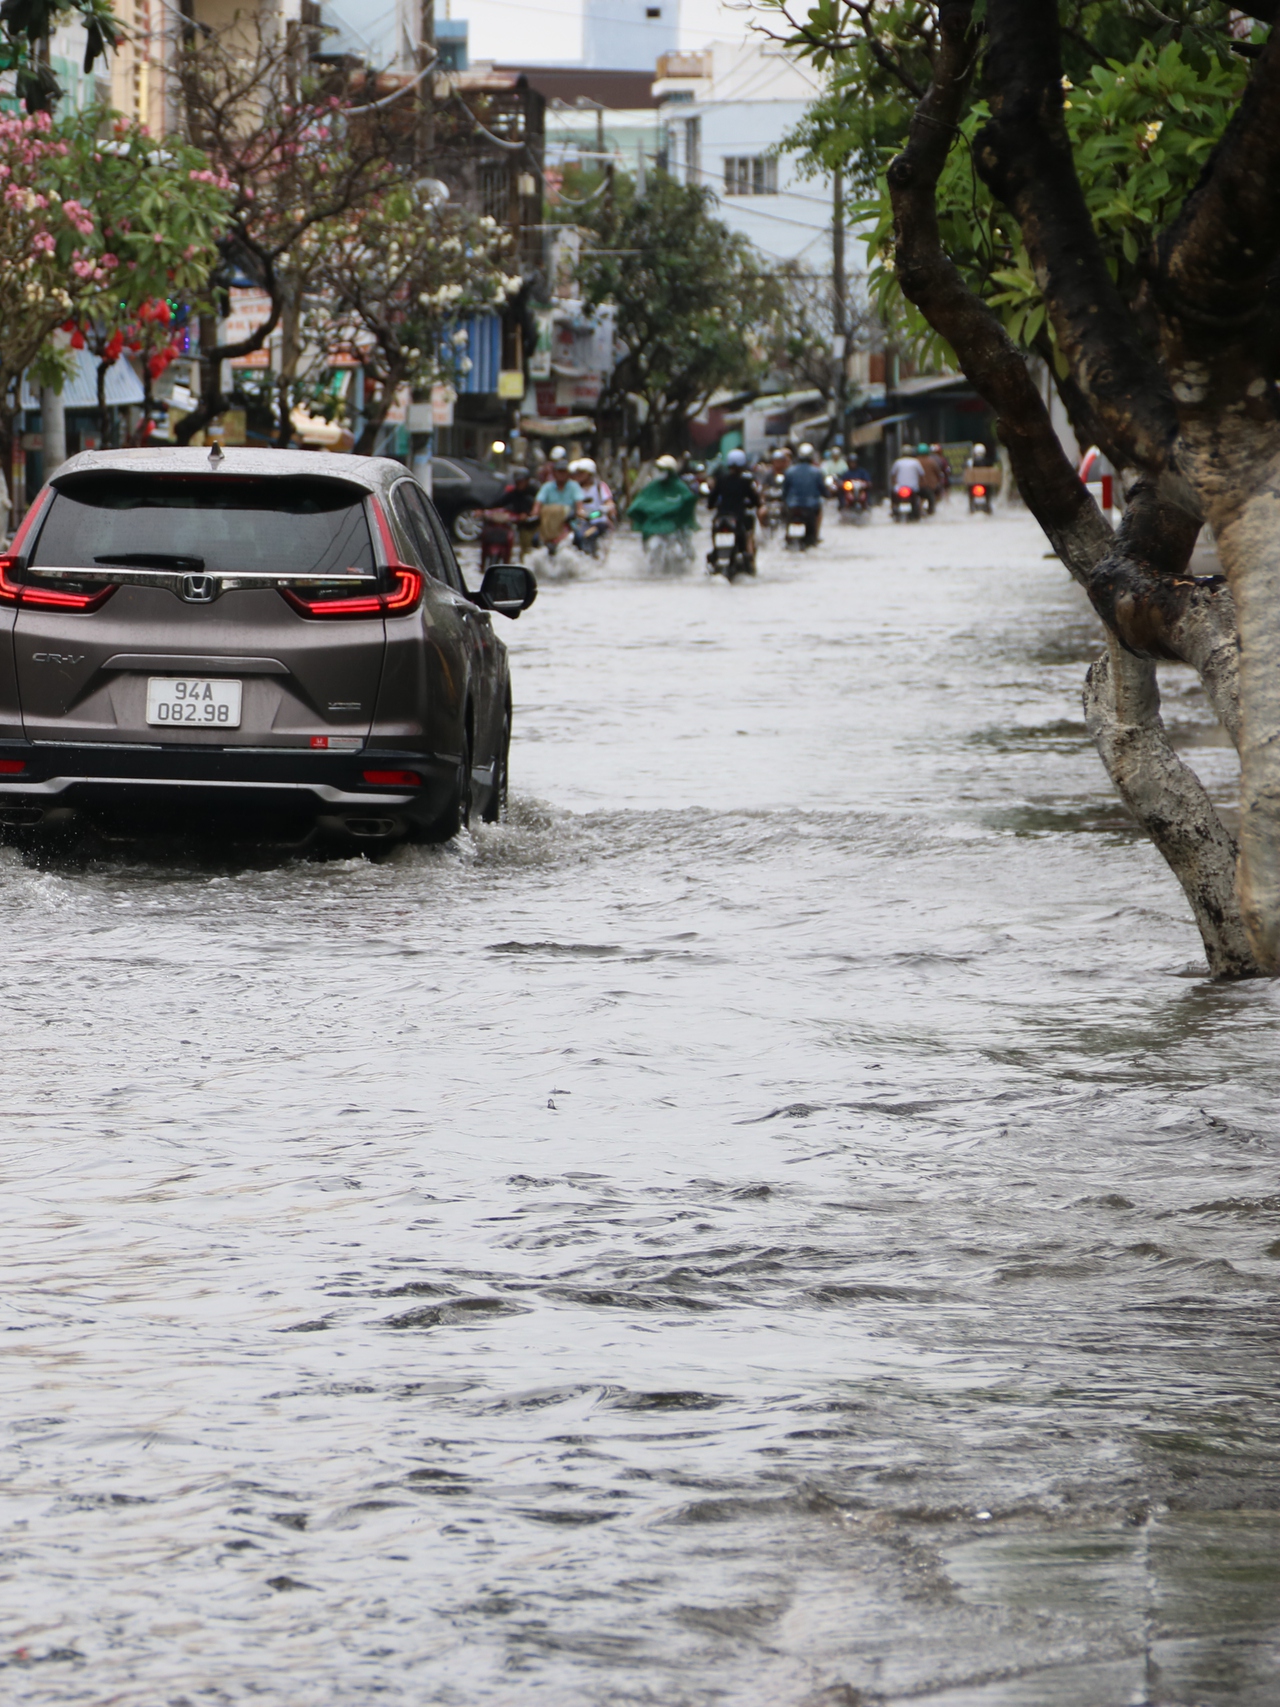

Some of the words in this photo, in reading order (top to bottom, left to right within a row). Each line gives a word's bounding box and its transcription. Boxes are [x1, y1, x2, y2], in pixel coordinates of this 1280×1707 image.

[31, 652, 85, 665] CR-V
[175, 682, 213, 701] 94A
[157, 703, 230, 722] 082.98
